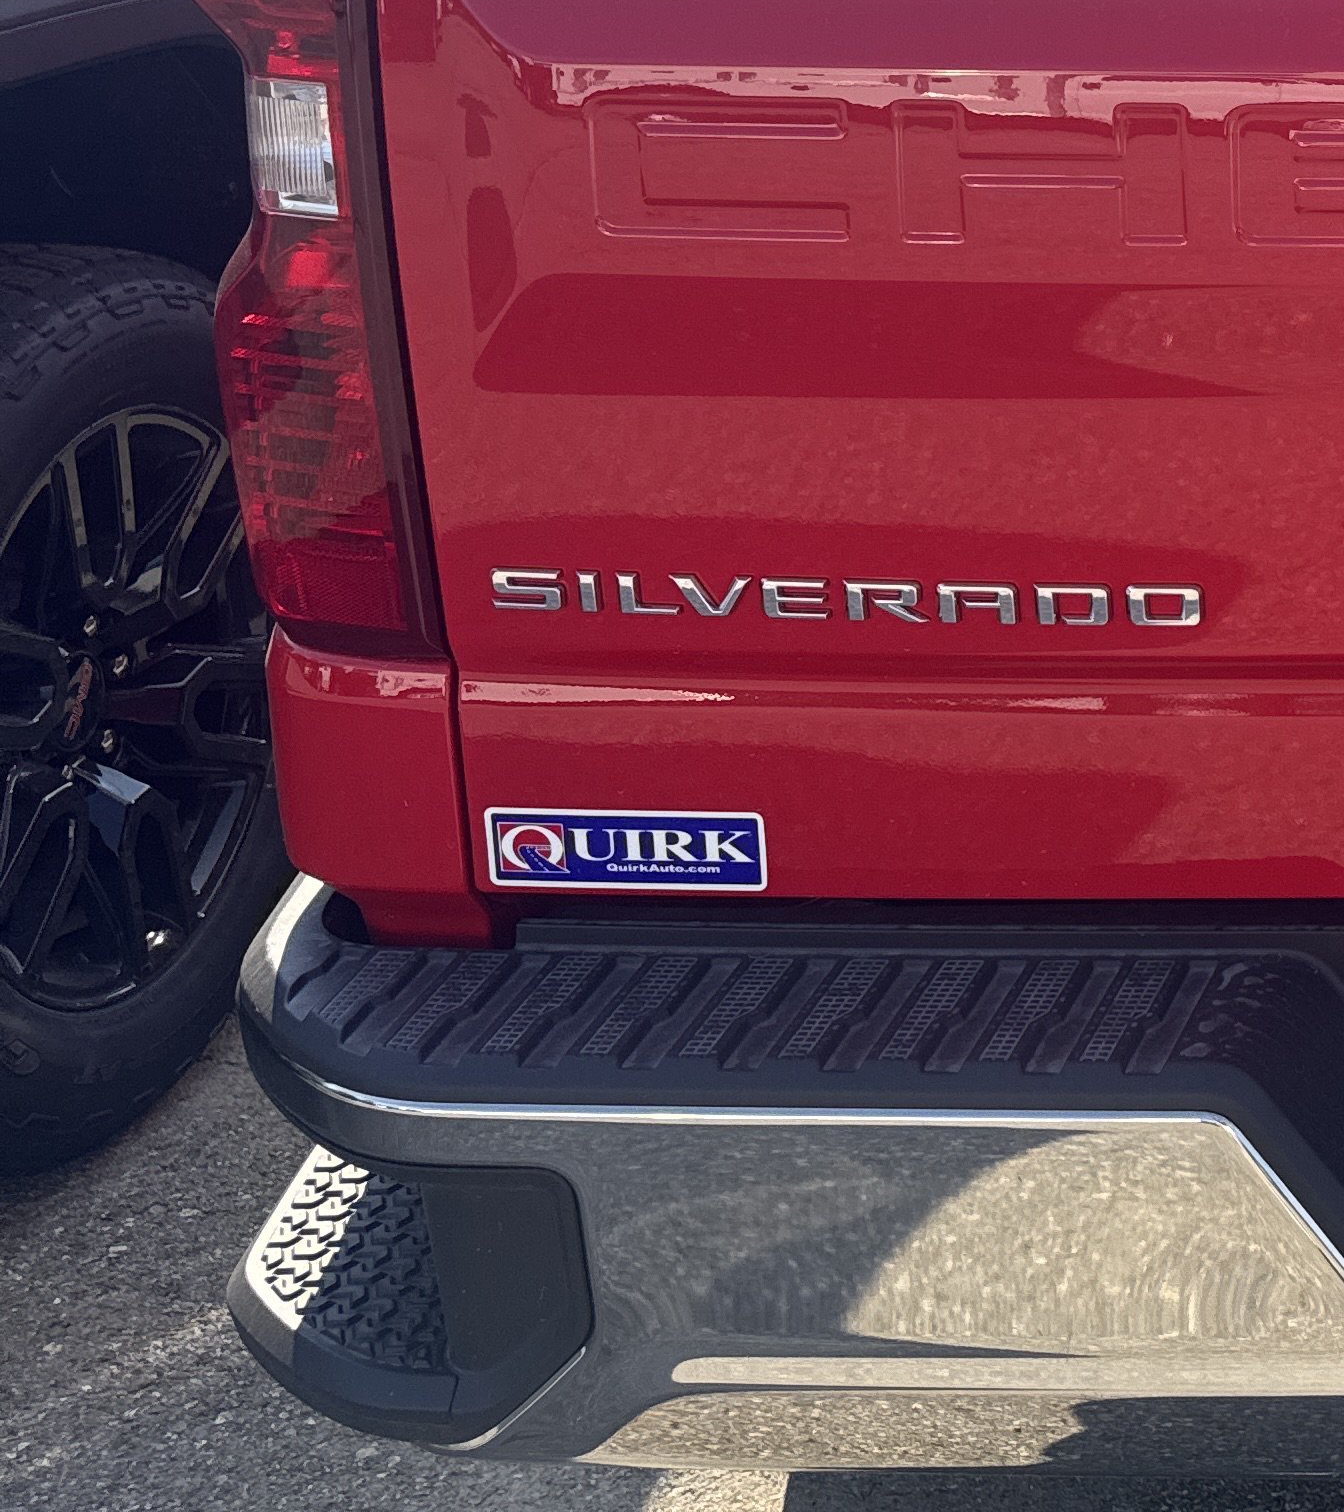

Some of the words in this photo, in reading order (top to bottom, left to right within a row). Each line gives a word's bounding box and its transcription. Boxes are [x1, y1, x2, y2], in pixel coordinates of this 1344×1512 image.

[489, 567, 1205, 627] SILVERADO
[500, 824, 755, 873] QUIRK
[606, 862, 721, 874] QuirkAuto.com
